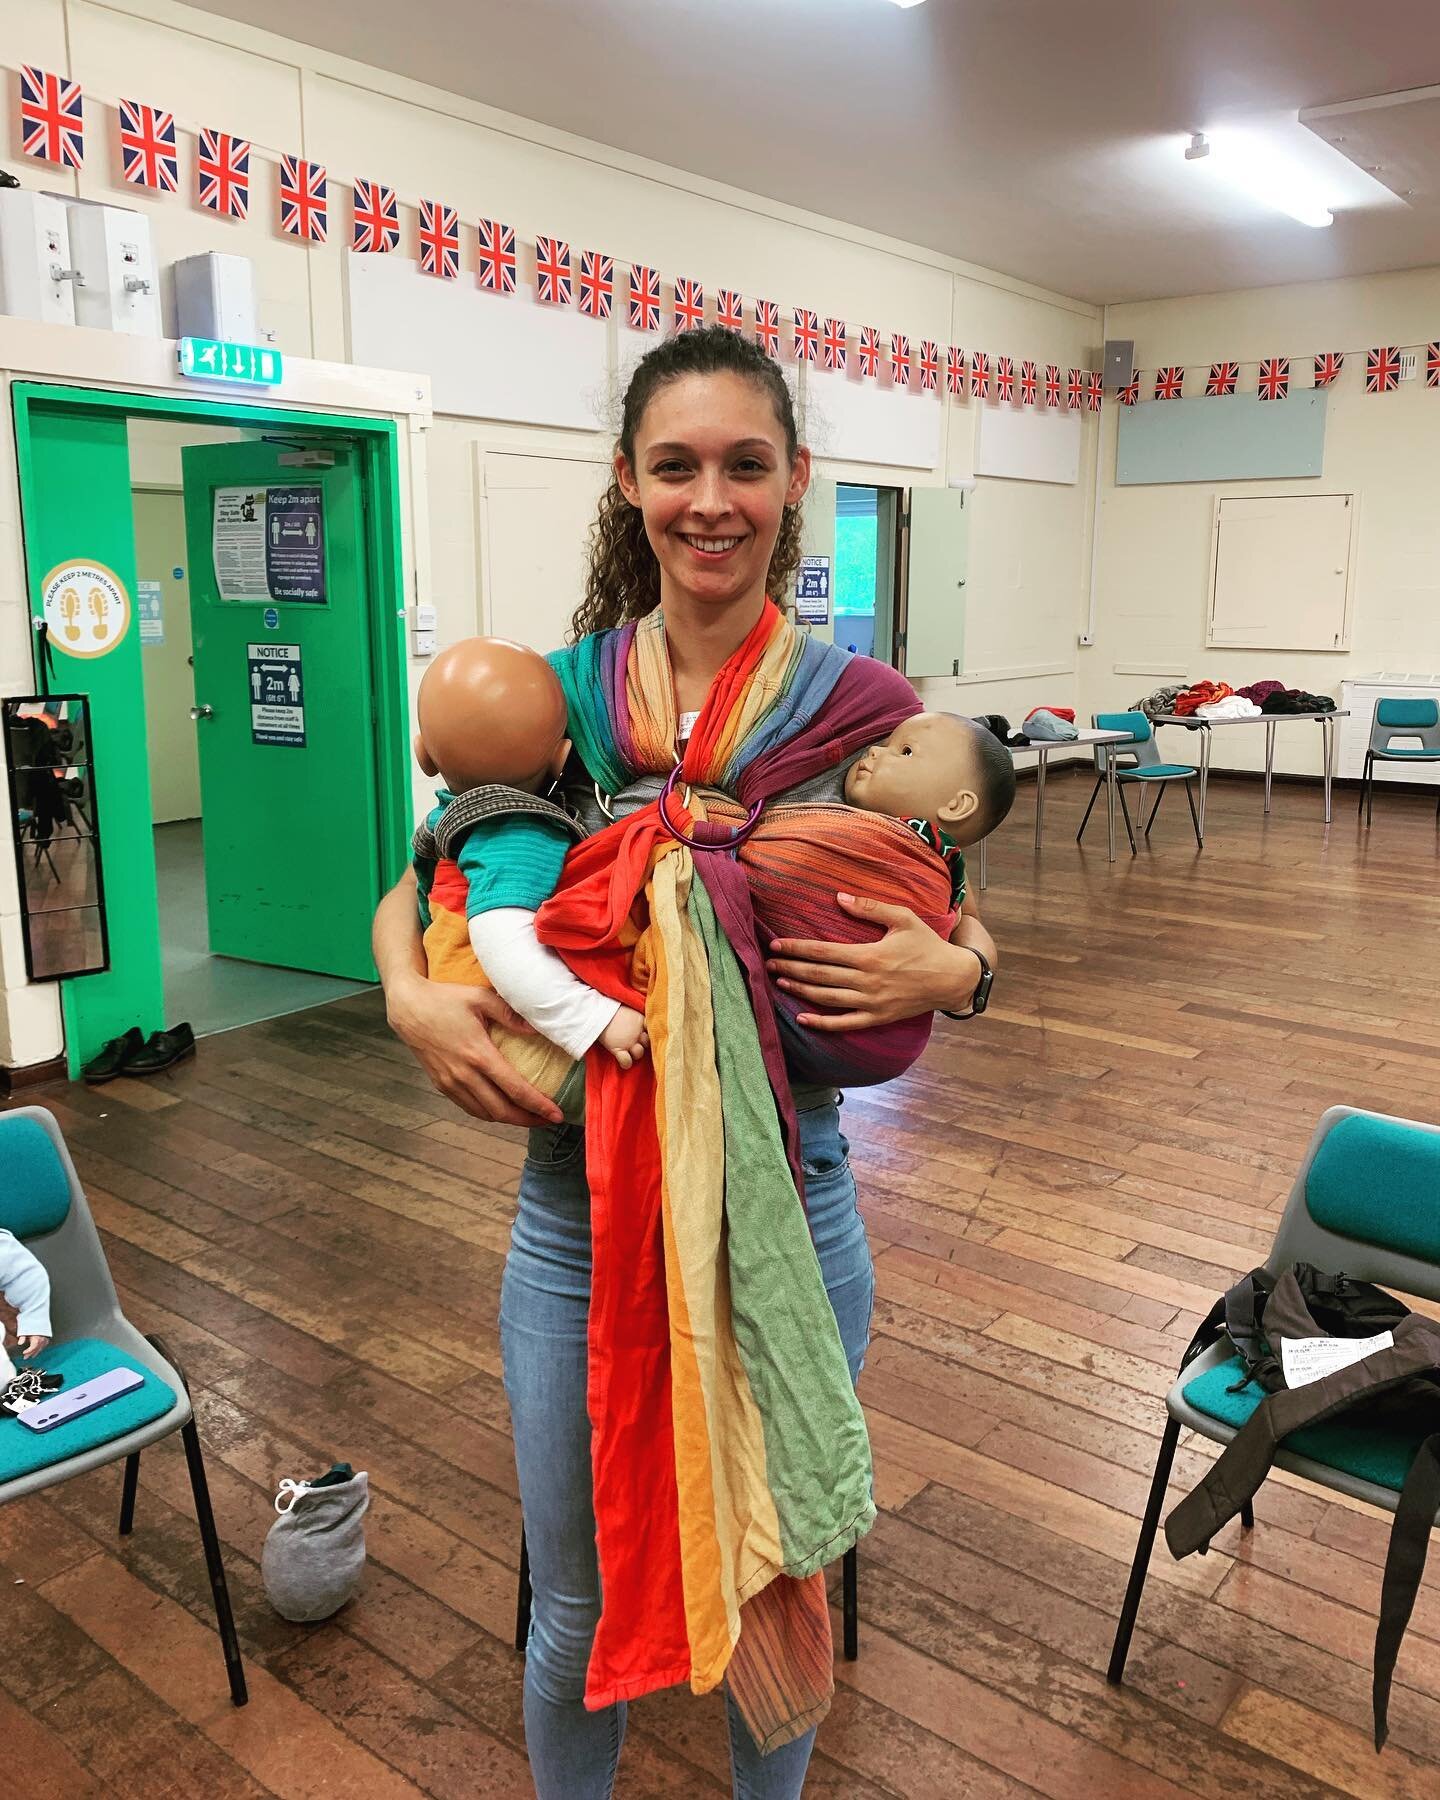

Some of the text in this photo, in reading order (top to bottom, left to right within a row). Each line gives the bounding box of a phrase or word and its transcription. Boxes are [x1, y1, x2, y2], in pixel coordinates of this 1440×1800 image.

[268, 494, 288, 505] Keep
[288, 494, 298, 504] 2m
[300, 495, 320, 505] apart
[46, 582, 60, 607] PLEASE
[59, 572, 75, 584] KEEP
[82, 571, 107, 585] METRES
[106, 584, 121, 604] APART
[806, 579, 818, 588] 2m
[274, 587, 319, 598] Be socially safe
[257, 648, 288, 658] NOTICE
[266, 677, 284, 690] 2m
